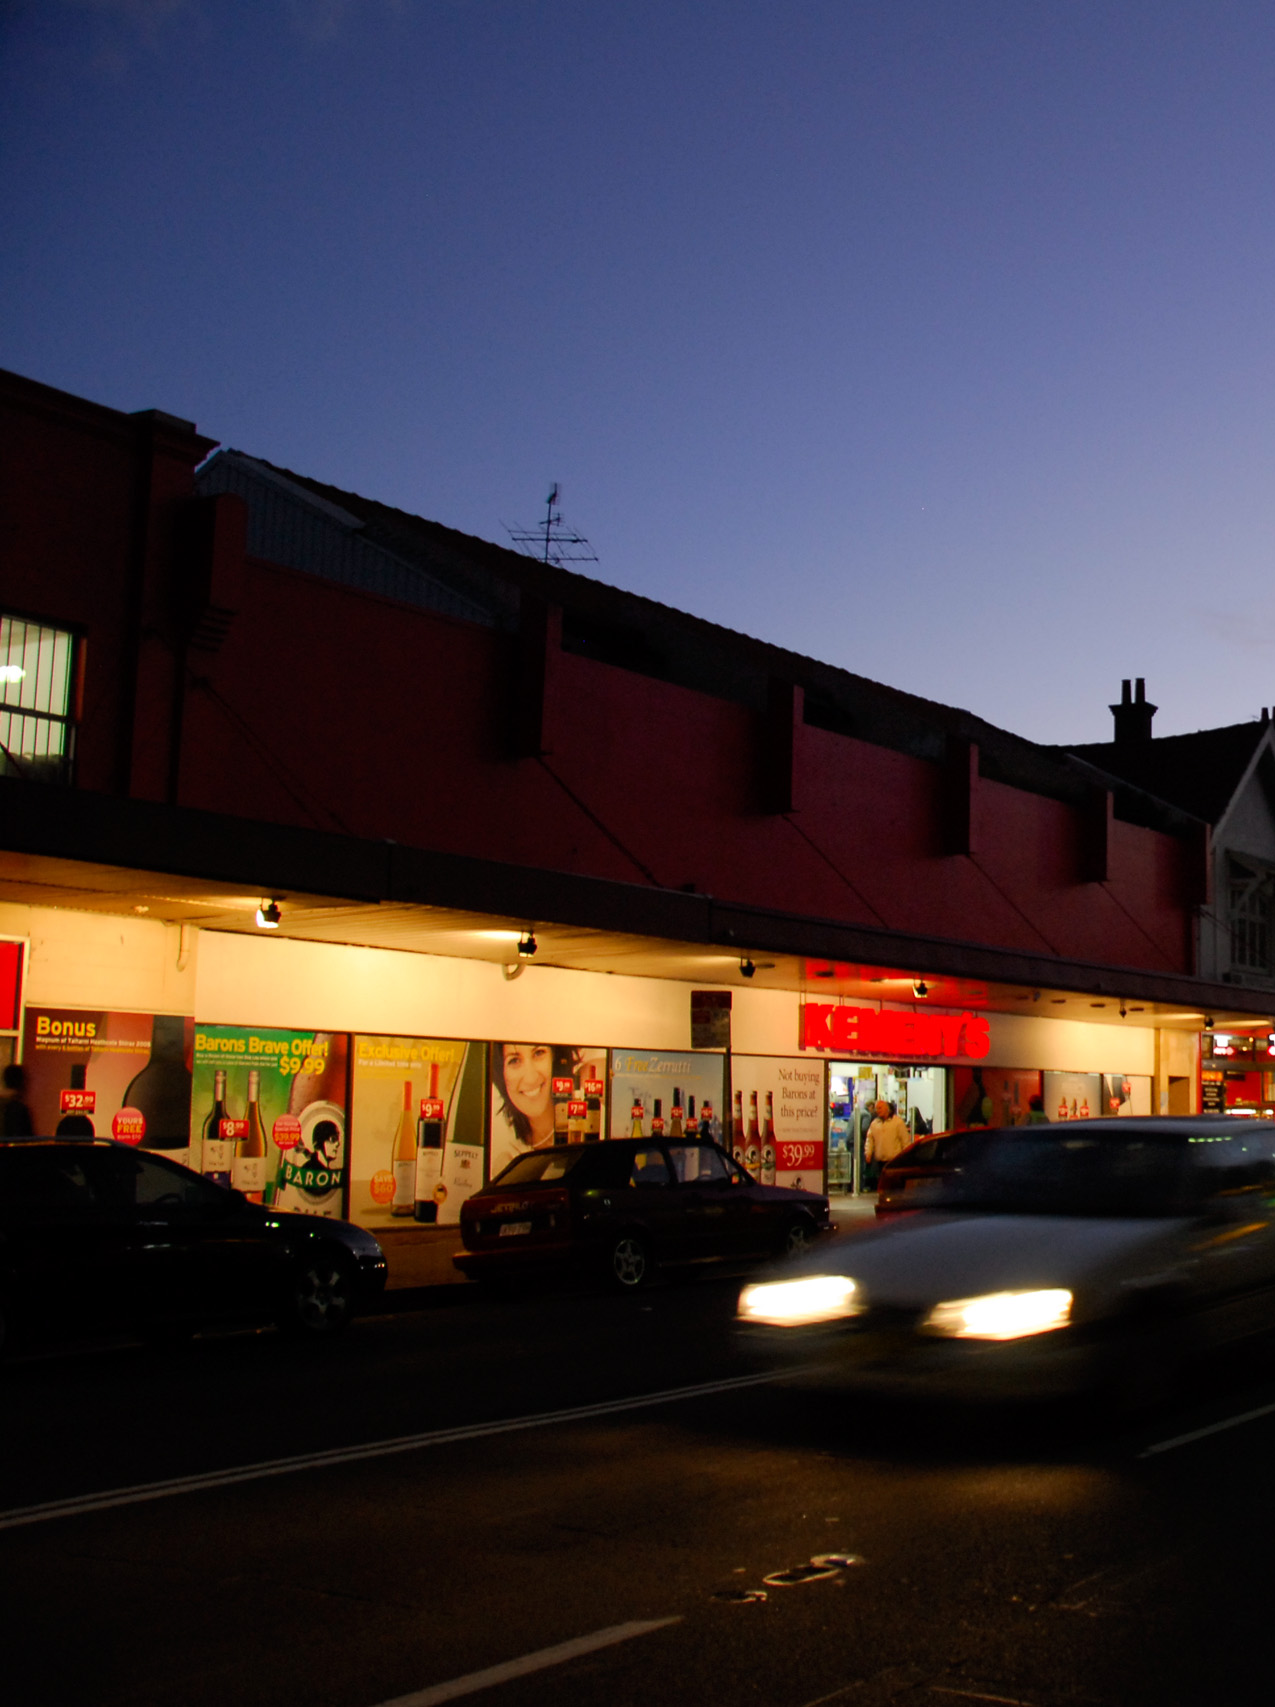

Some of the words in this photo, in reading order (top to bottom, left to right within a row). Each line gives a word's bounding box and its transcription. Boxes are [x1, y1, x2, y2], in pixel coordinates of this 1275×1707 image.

[37, 1016, 97, 1037] Bonus
[195, 1034, 246, 1053] Barons
[249, 1036, 289, 1055] Brave
[291, 1039, 329, 1057] Offer!
[358, 1042, 419, 1060] Exclusive
[420, 1046, 455, 1062] Offer!
[279, 1055, 326, 1076] $9.99
[614, 1055, 622, 1071] 6
[779, 1069, 793, 1081] Not
[794, 1068, 820, 1086] buying
[782, 1087, 808, 1100] Barons
[809, 1090, 816, 1100] at
[117, 1117, 143, 1125] YOURS
[781, 1105, 795, 1118] this
[796, 1106, 818, 1121] price?
[117, 1124, 142, 1134] FREE
[285, 1164, 341, 1187] BARON
